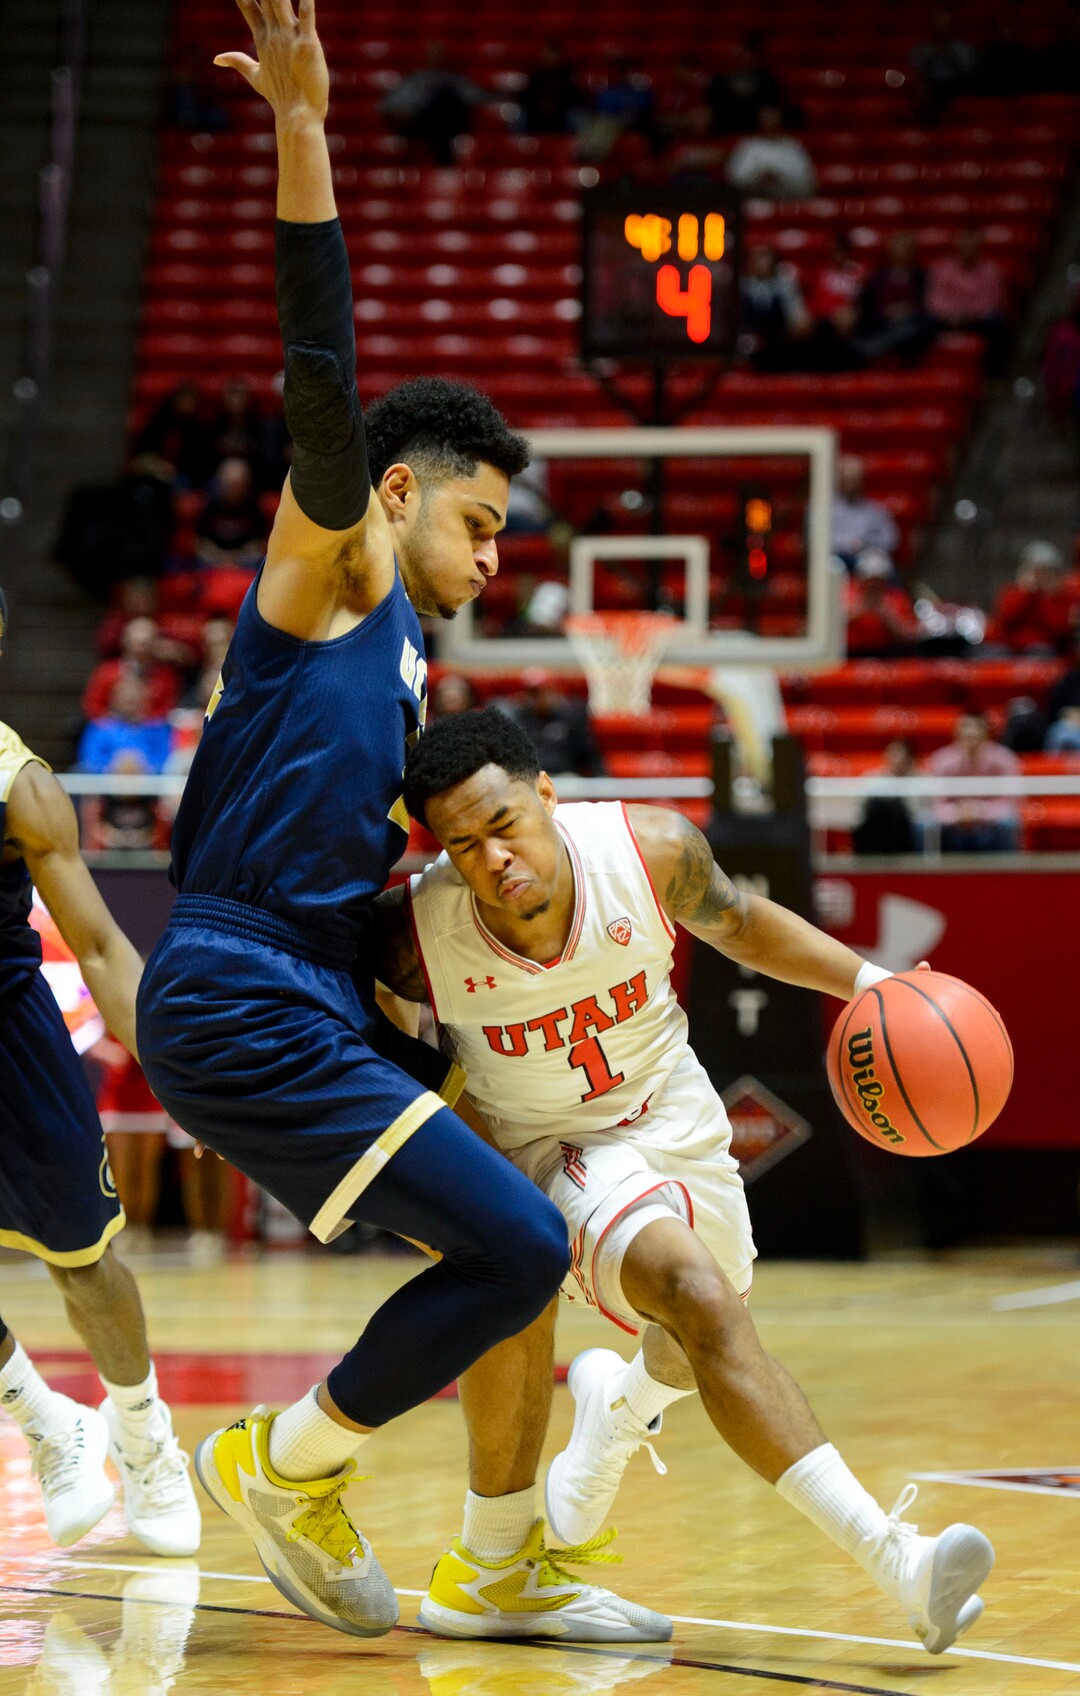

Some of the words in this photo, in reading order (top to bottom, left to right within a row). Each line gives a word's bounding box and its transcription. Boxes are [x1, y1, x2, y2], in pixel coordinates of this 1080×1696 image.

[656, 264, 712, 343] 4
[481, 970, 650, 1057] UTAH
[567, 1035, 625, 1103] 1
[847, 1025, 907, 1146] Wilson
